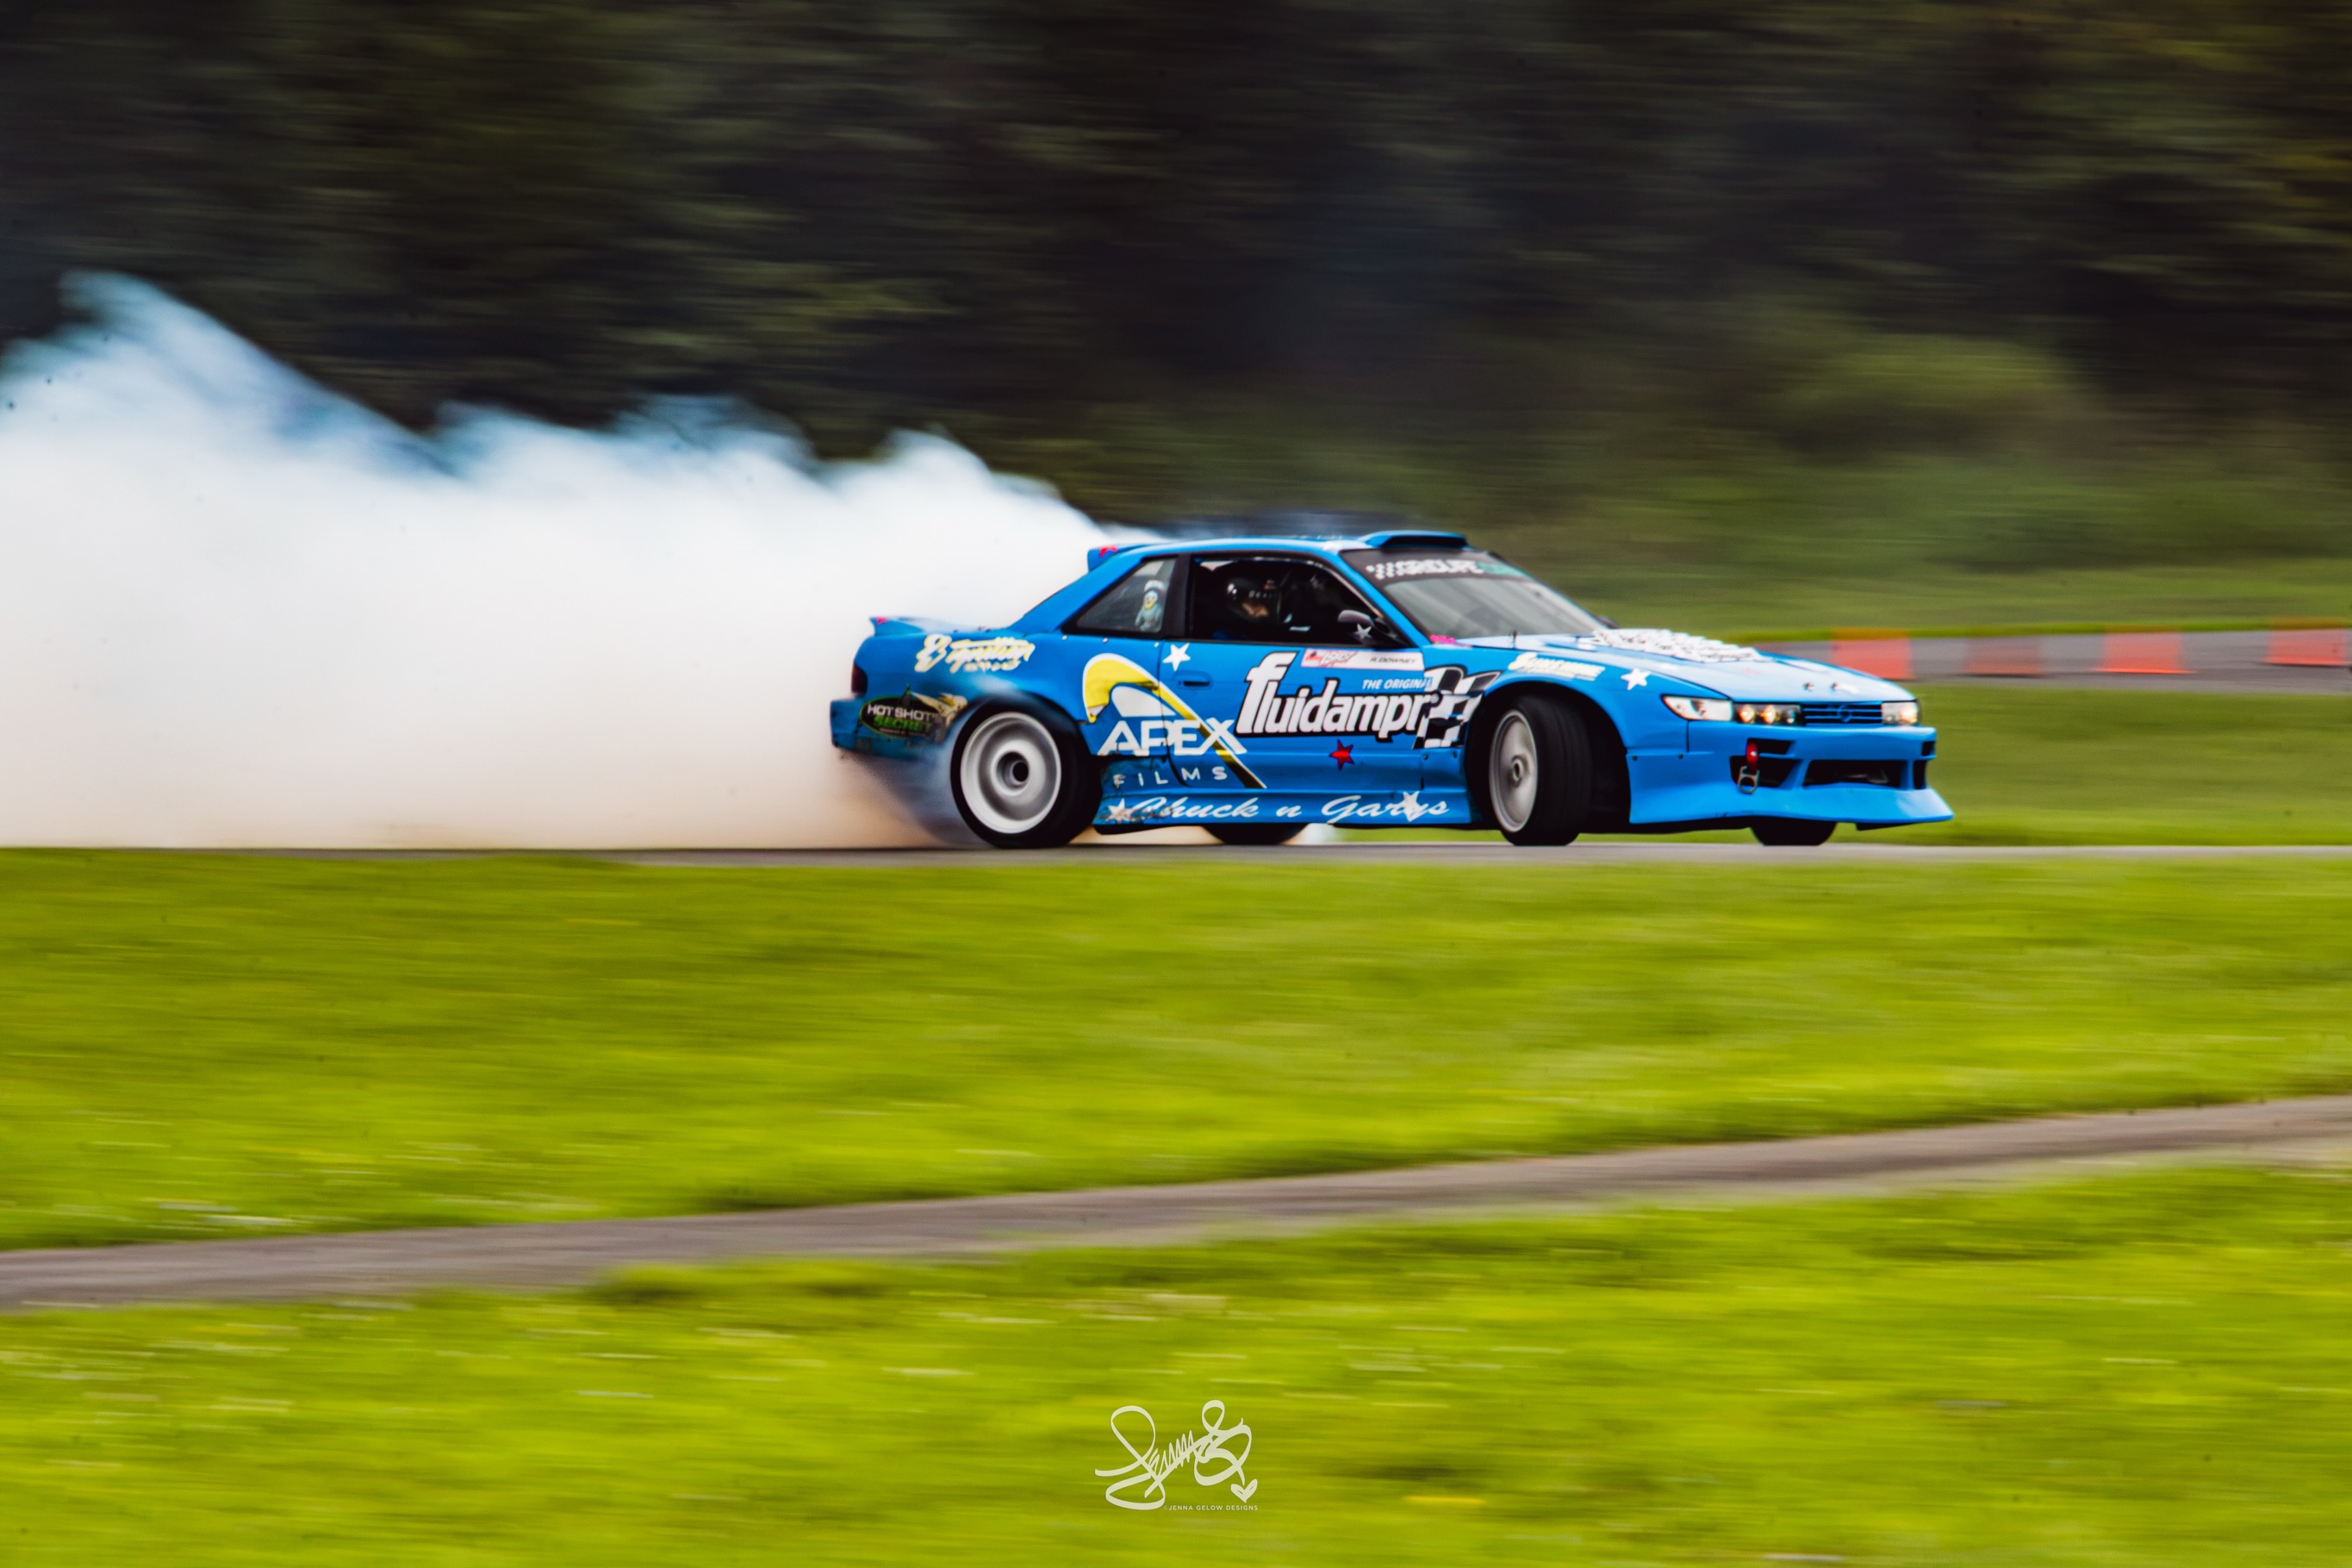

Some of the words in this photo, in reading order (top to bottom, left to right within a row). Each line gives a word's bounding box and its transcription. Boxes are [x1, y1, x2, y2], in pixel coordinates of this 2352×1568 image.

[1362, 679, 1383, 690] THE
[1235, 651, 1431, 739] fluidampr
[867, 704, 893, 717] HOT
[1097, 717, 1248, 756] APEX
[1113, 766, 1228, 788] FILMS
[1276, 805, 1303, 818] n
